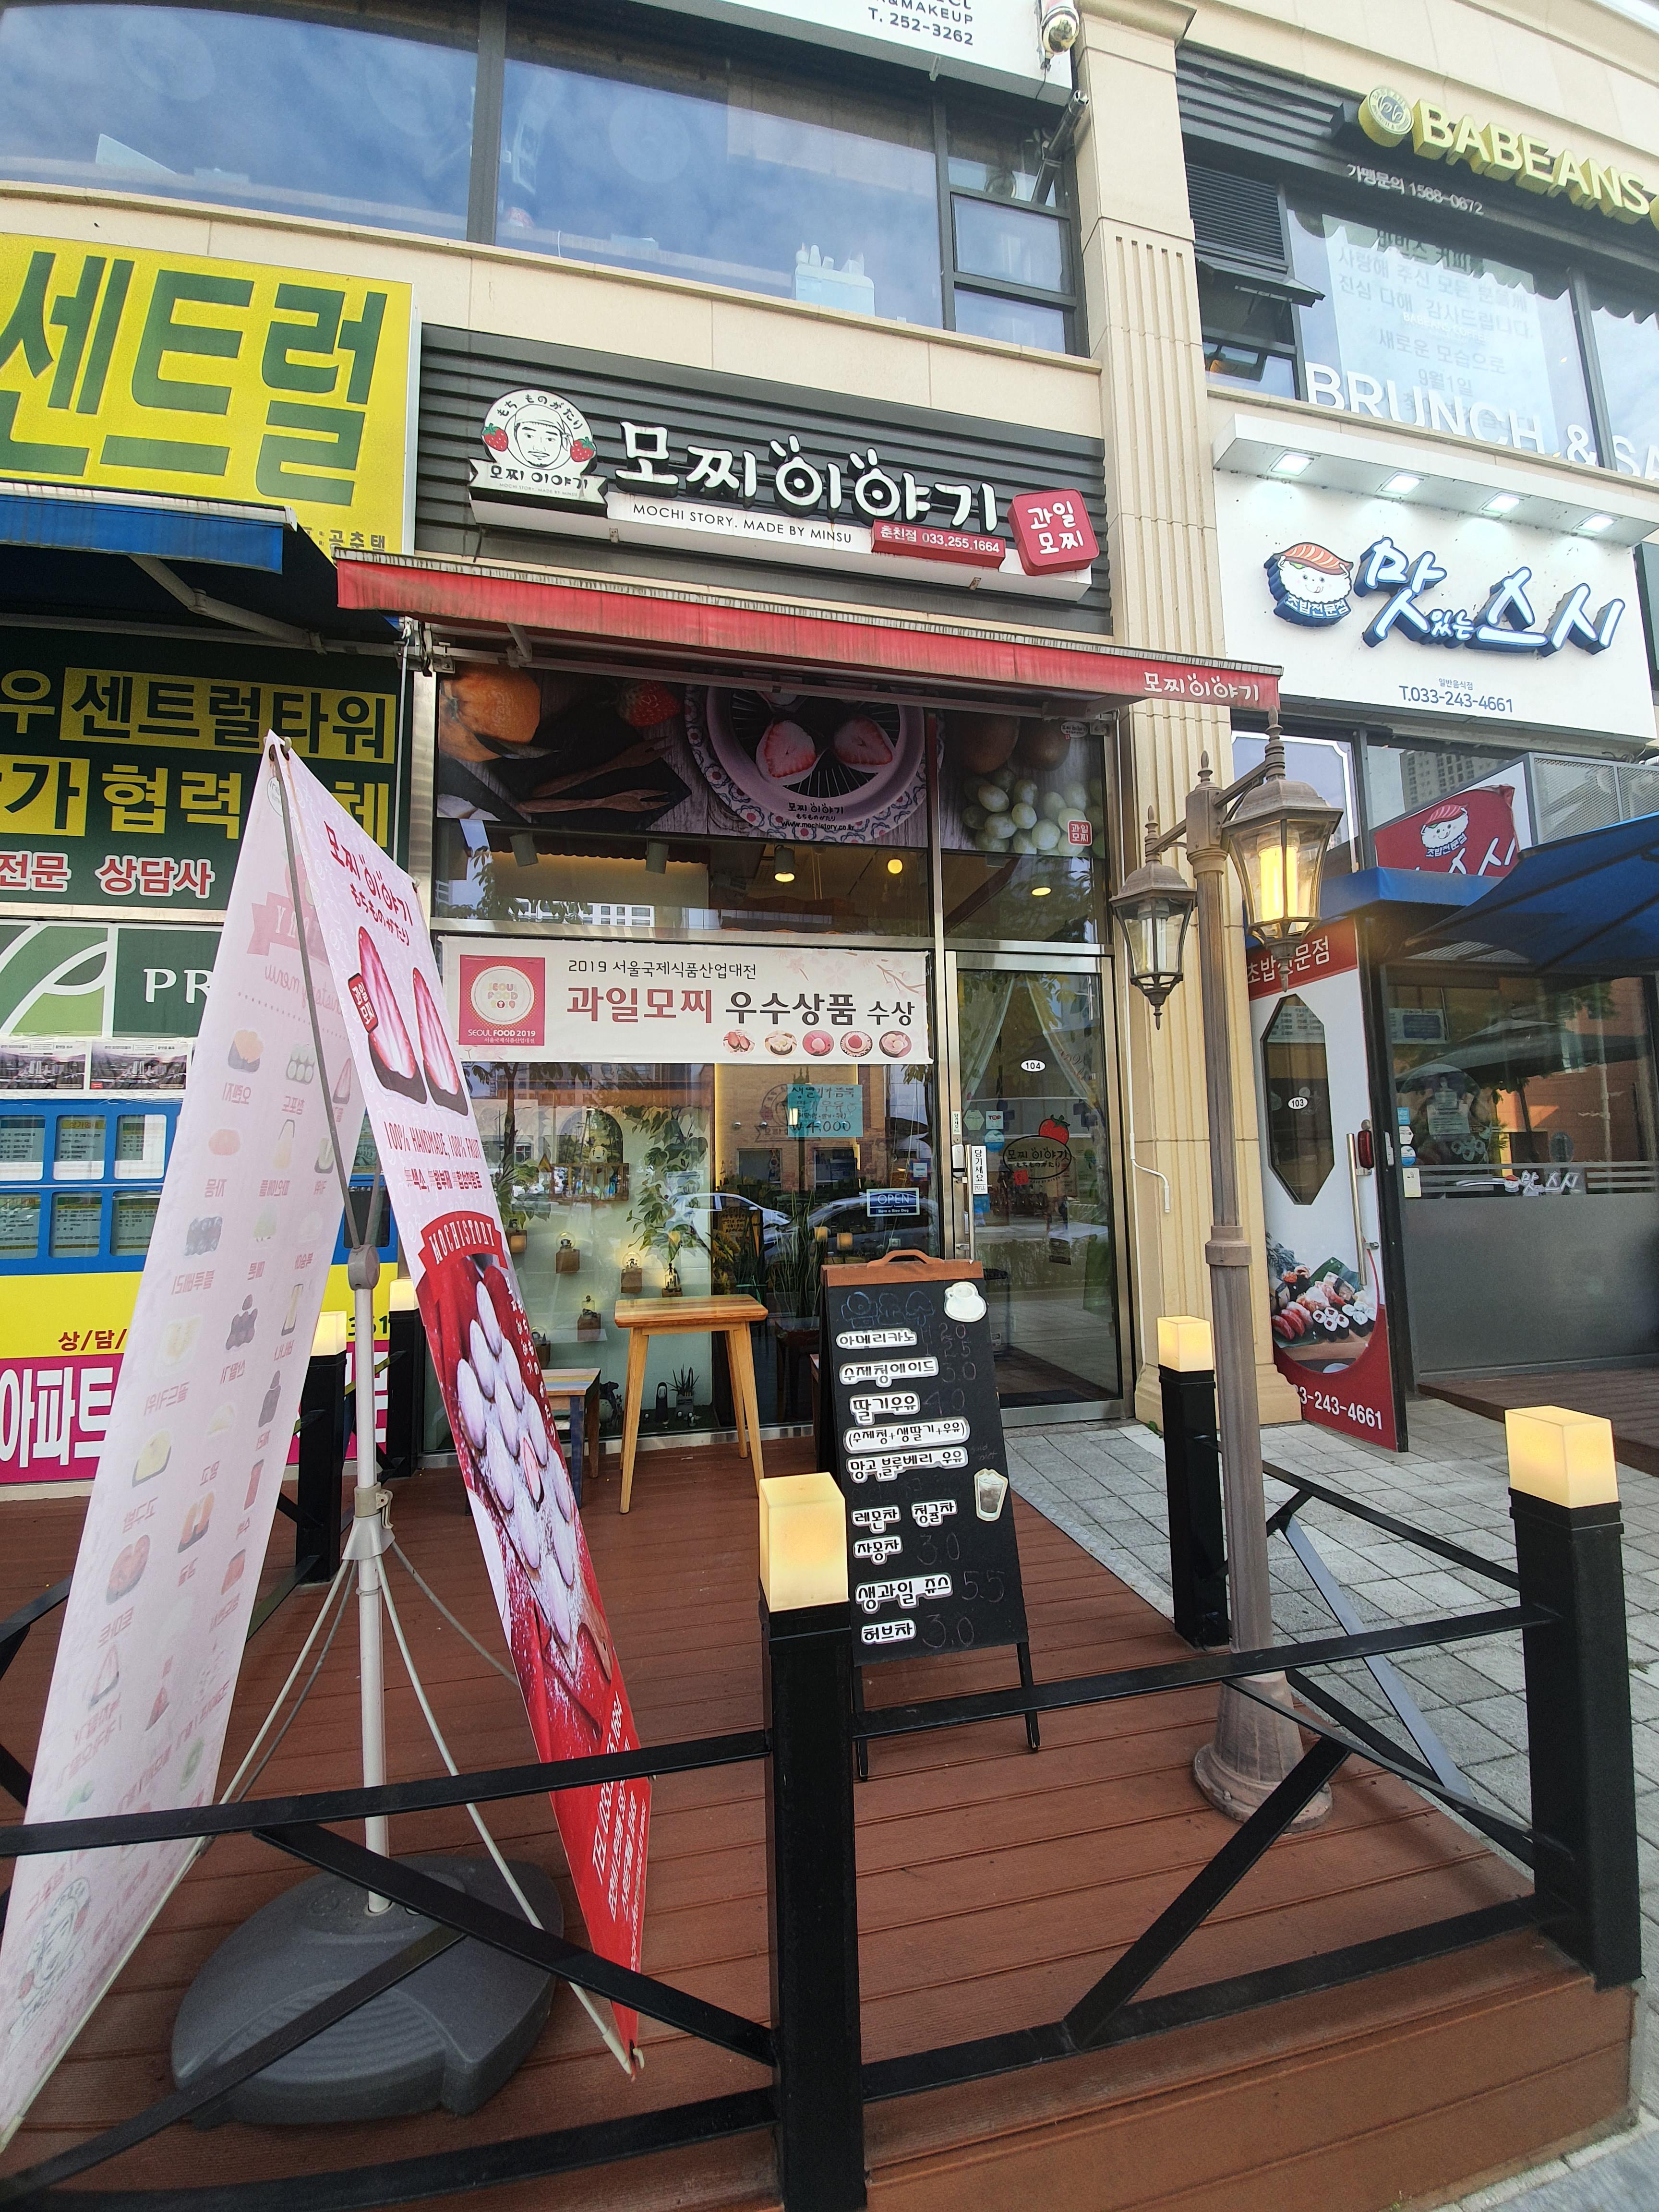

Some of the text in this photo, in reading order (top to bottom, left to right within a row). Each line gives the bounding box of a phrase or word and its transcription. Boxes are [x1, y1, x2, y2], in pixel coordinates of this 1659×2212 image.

[868, 7, 974, 46] T. 252-3262
[1416, 99, 1651, 216] BABEANS
[0, 251, 388, 507] 센트럴
[1305, 362, 1545, 455] BRUNCH
[531, 472, 588, 490] 이야기
[633, 504, 852, 543] MOCHI STORY. MADE BY MINSU
[1027, 501, 1076, 529] 과일
[921, 531, 1000, 553] 033.255.1664
[1038, 530, 1084, 554] 모찌
[1438, 678, 1474, 690] 일반음식점
[1399, 685, 1513, 714] T.033-243-4661
[1071, 823, 1088, 834] 과일
[1071, 833, 1089, 843] 모찌
[99, 858, 214, 897] 상담사
[568, 960, 757, 981] 2019 서울국제식품산업대전
[1248, 935, 1330, 984] 초밥문점
[566, 986, 916, 1026] 과일모찌 우수상품 수상
[468, 1029, 492, 1037] SEOUL
[1025, 1061, 1042, 1070] 104
[1290, 1098, 1305, 1108] 103
[384, 1121, 411, 1152] 100%
[448, 1134, 467, 1158] 100%
[974, 1149, 984, 1182] 당기세요
[878, 1194, 910, 1204] OPEN
[428, 1218, 496, 1265] MOCHISTORY
[839, 1331, 915, 1346] 아메리카노
[843, 1360, 934, 1384] 수제청에이드
[853, 1395, 916, 1421] 딸기우유
[1292, 1384, 1382, 1431] 3-243-4661
[941, 1451, 963, 1463] 우유
[854, 1502, 955, 1530] 레몬차 청귤차
[856, 1539, 900, 1561] 자몽차
[858, 1576, 950, 1610] 생과일 쥬스
[863, 1623, 914, 1641] 허브차
[592, 1824, 607, 1886] TEL
